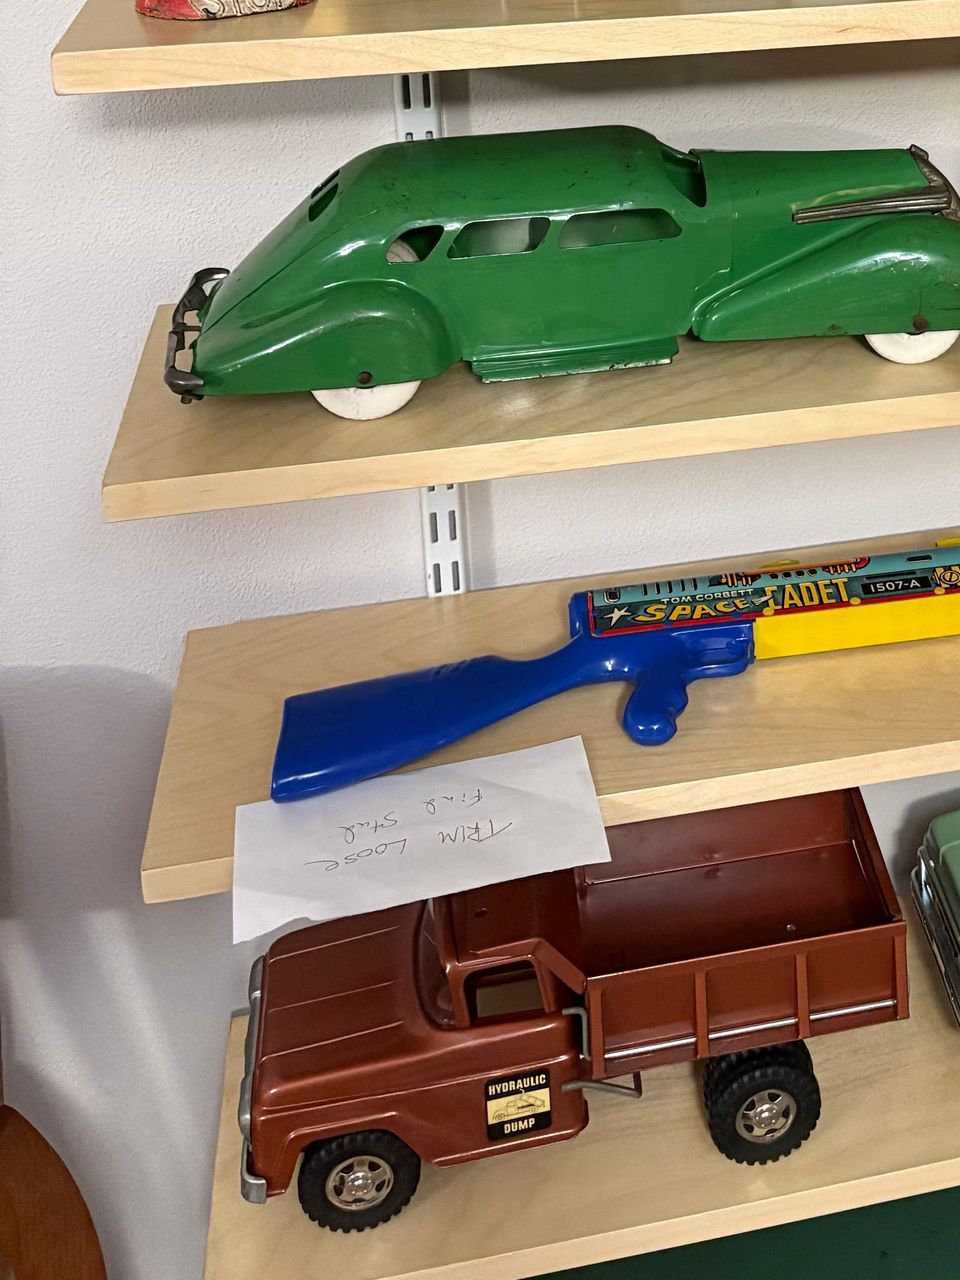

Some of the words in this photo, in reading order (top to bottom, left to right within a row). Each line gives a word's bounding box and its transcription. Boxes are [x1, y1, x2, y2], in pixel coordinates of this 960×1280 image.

[661, 595, 692, 605] TOM
[695, 588, 754, 602] CORBETT
[870, 579, 921, 593] 1507-A
[633, 597, 751, 622] SPACE
[765, 578, 850, 611] CADET
[337, 811, 399, 842] Stud
[438, 819, 513, 846] TRIM
[488, 1074, 547, 1096] HYDRAULIC
[504, 1118, 535, 1134] DUMP
